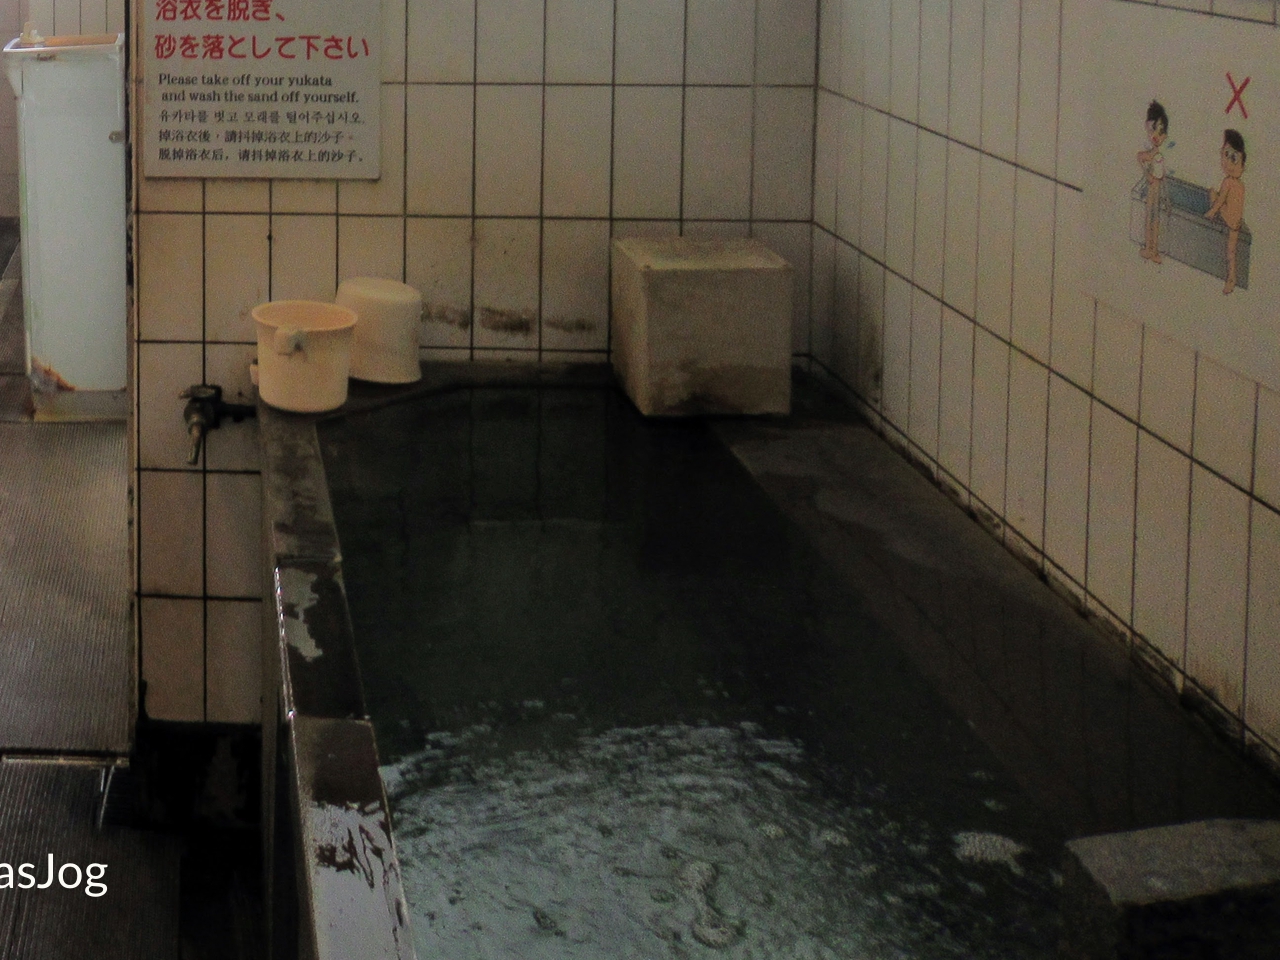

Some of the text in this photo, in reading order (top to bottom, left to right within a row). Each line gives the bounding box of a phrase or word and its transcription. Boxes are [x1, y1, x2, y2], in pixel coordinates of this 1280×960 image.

[154, 34, 370, 60] 砂を落として下さい
[158, 73, 332, 88] Please take off your yukata
[161, 91, 359, 105] and wash the sand off yourself.
[159, 109, 207, 123] 유카타를
[214, 110, 239, 123] 벗고
[243, 110, 281, 124] 모래를
